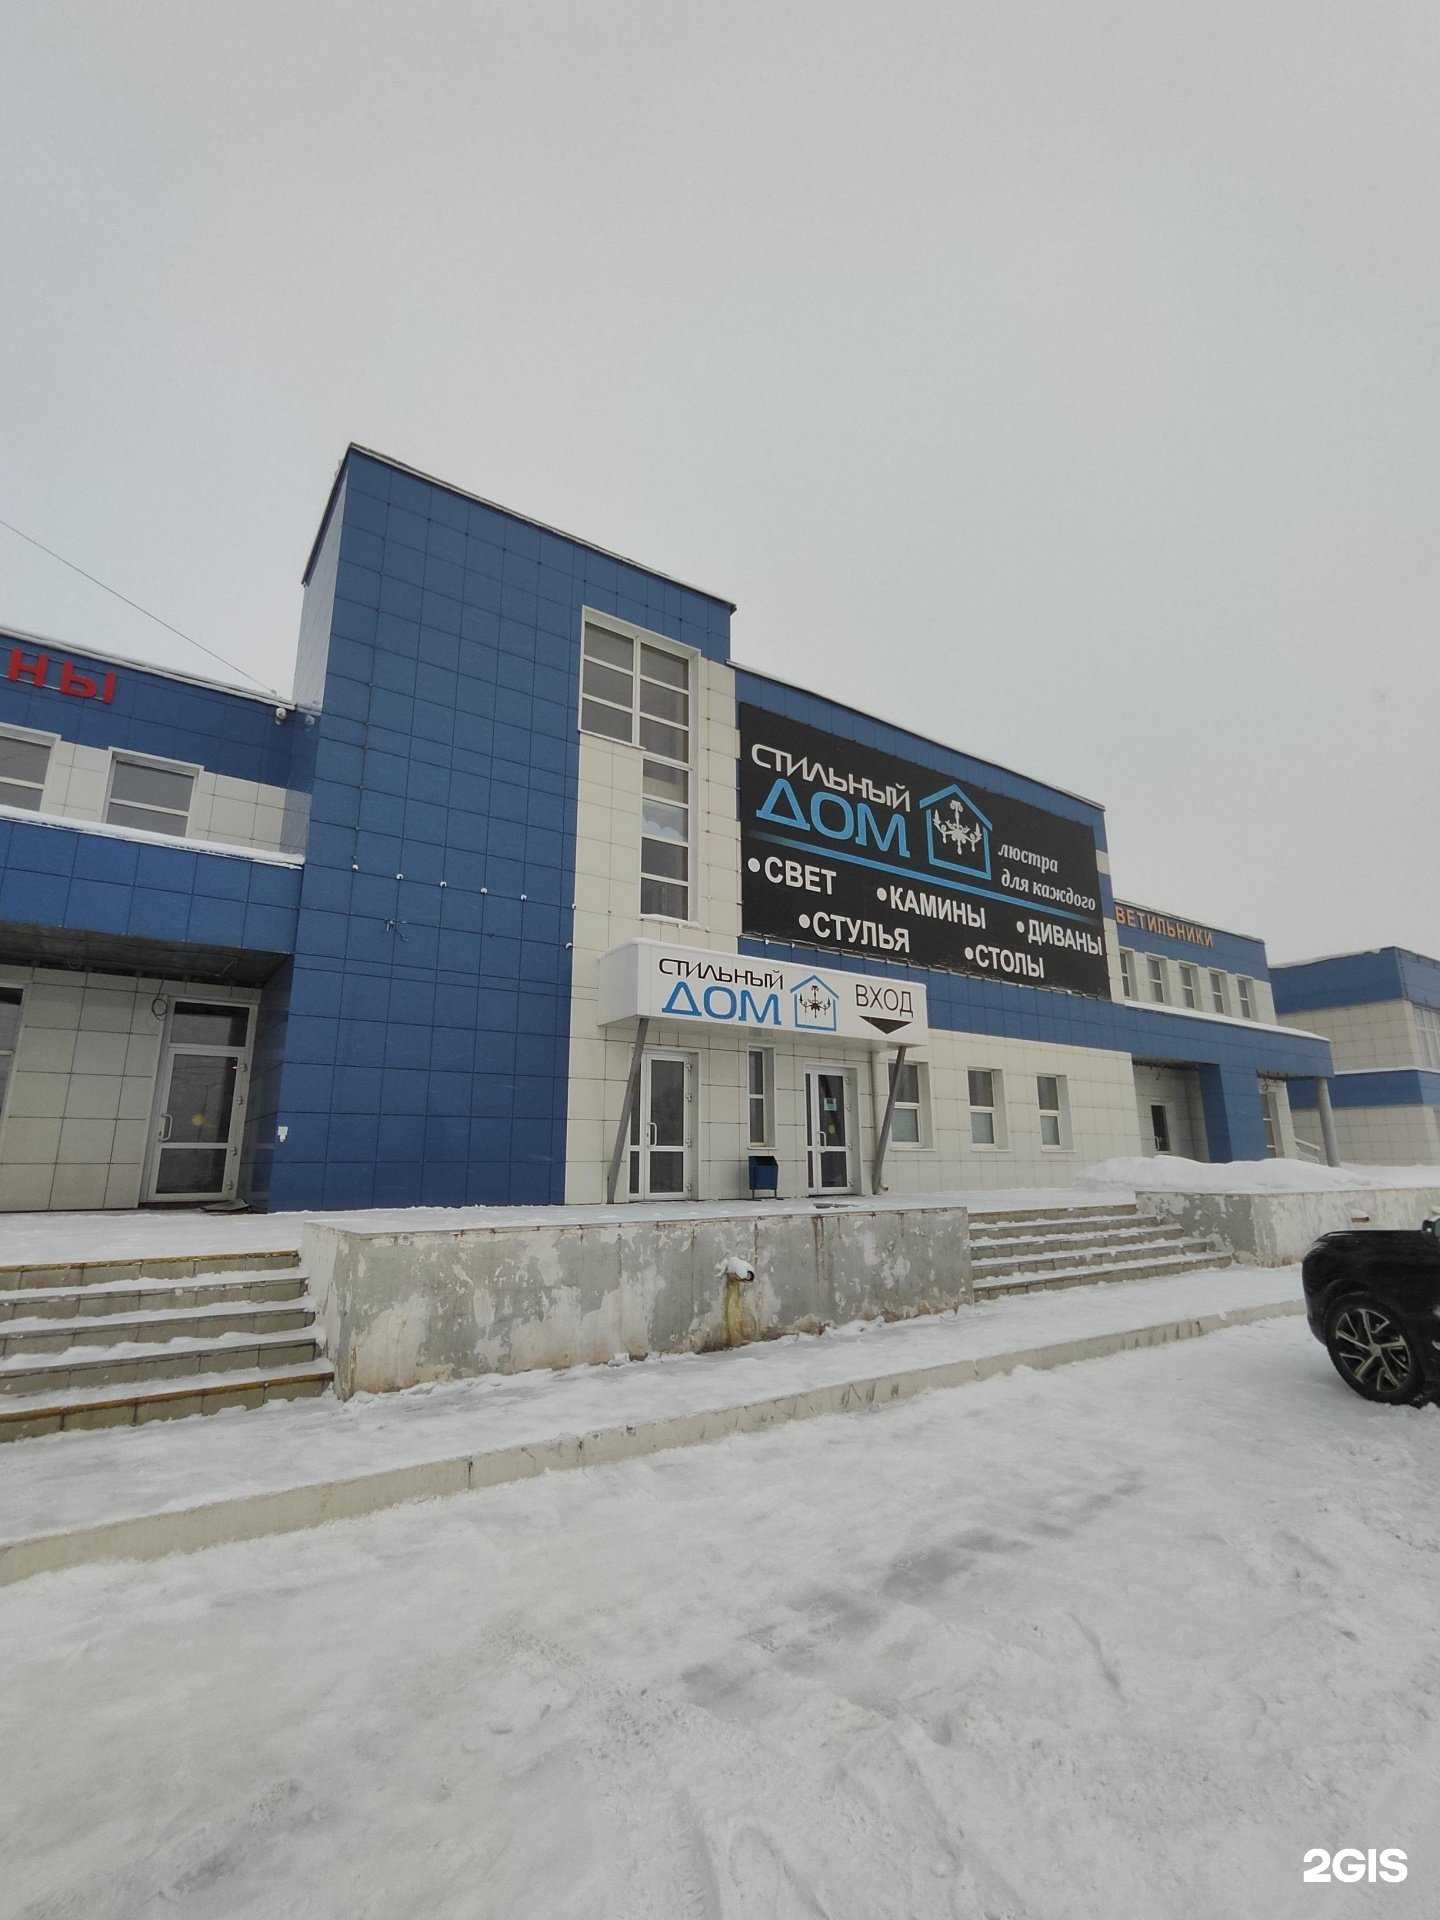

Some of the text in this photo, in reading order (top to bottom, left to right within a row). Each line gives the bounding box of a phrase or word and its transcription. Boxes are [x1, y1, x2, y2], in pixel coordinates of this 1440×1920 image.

[7, 646, 117, 704] НЫ
[751, 743, 911, 812] СТИЛЬНЫЙ
[756, 778, 911, 857] ДОМ
[764, 857, 836, 895] СВЕТ
[998, 843, 1058, 873] люстра
[890, 886, 986, 929] КАМИНЫ
[1001, 868, 1096, 911] для каждого
[812, 911, 910, 953] СТУЛЬЯ
[1027, 919, 1103, 956] ДИВАНЫ
[659, 958, 783, 990] СТИЛЬНЫЙ
[974, 945, 1043, 979] СТОЛЫ
[661, 980, 782, 1026] ДОМ
[855, 983, 914, 1018] ВХОД
